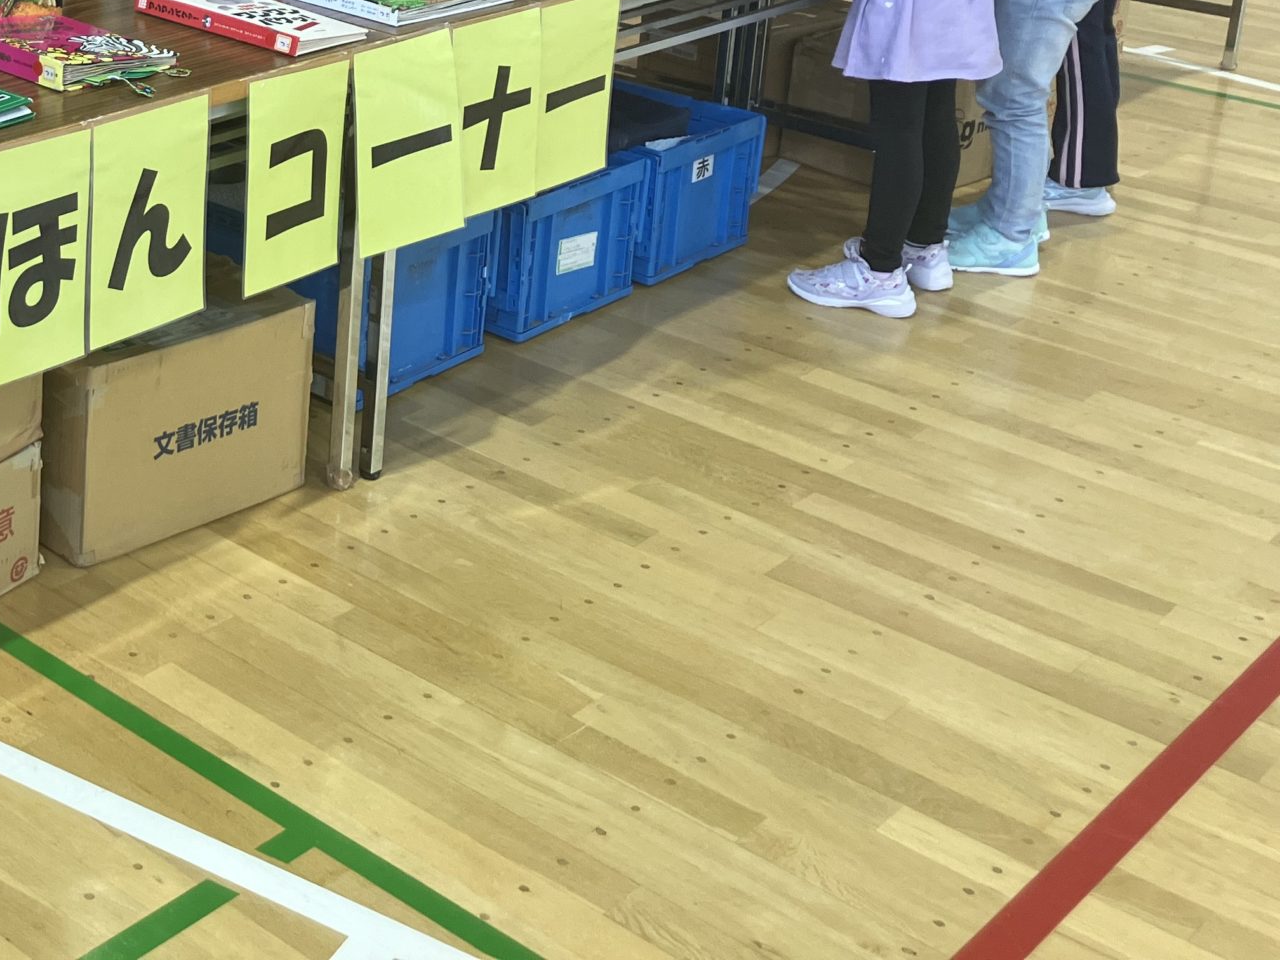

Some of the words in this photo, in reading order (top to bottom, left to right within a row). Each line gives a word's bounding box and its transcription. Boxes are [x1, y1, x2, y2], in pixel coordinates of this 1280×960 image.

[696, 158, 710, 179] 赤
[153, 401, 259, 460] 文書保存箱
